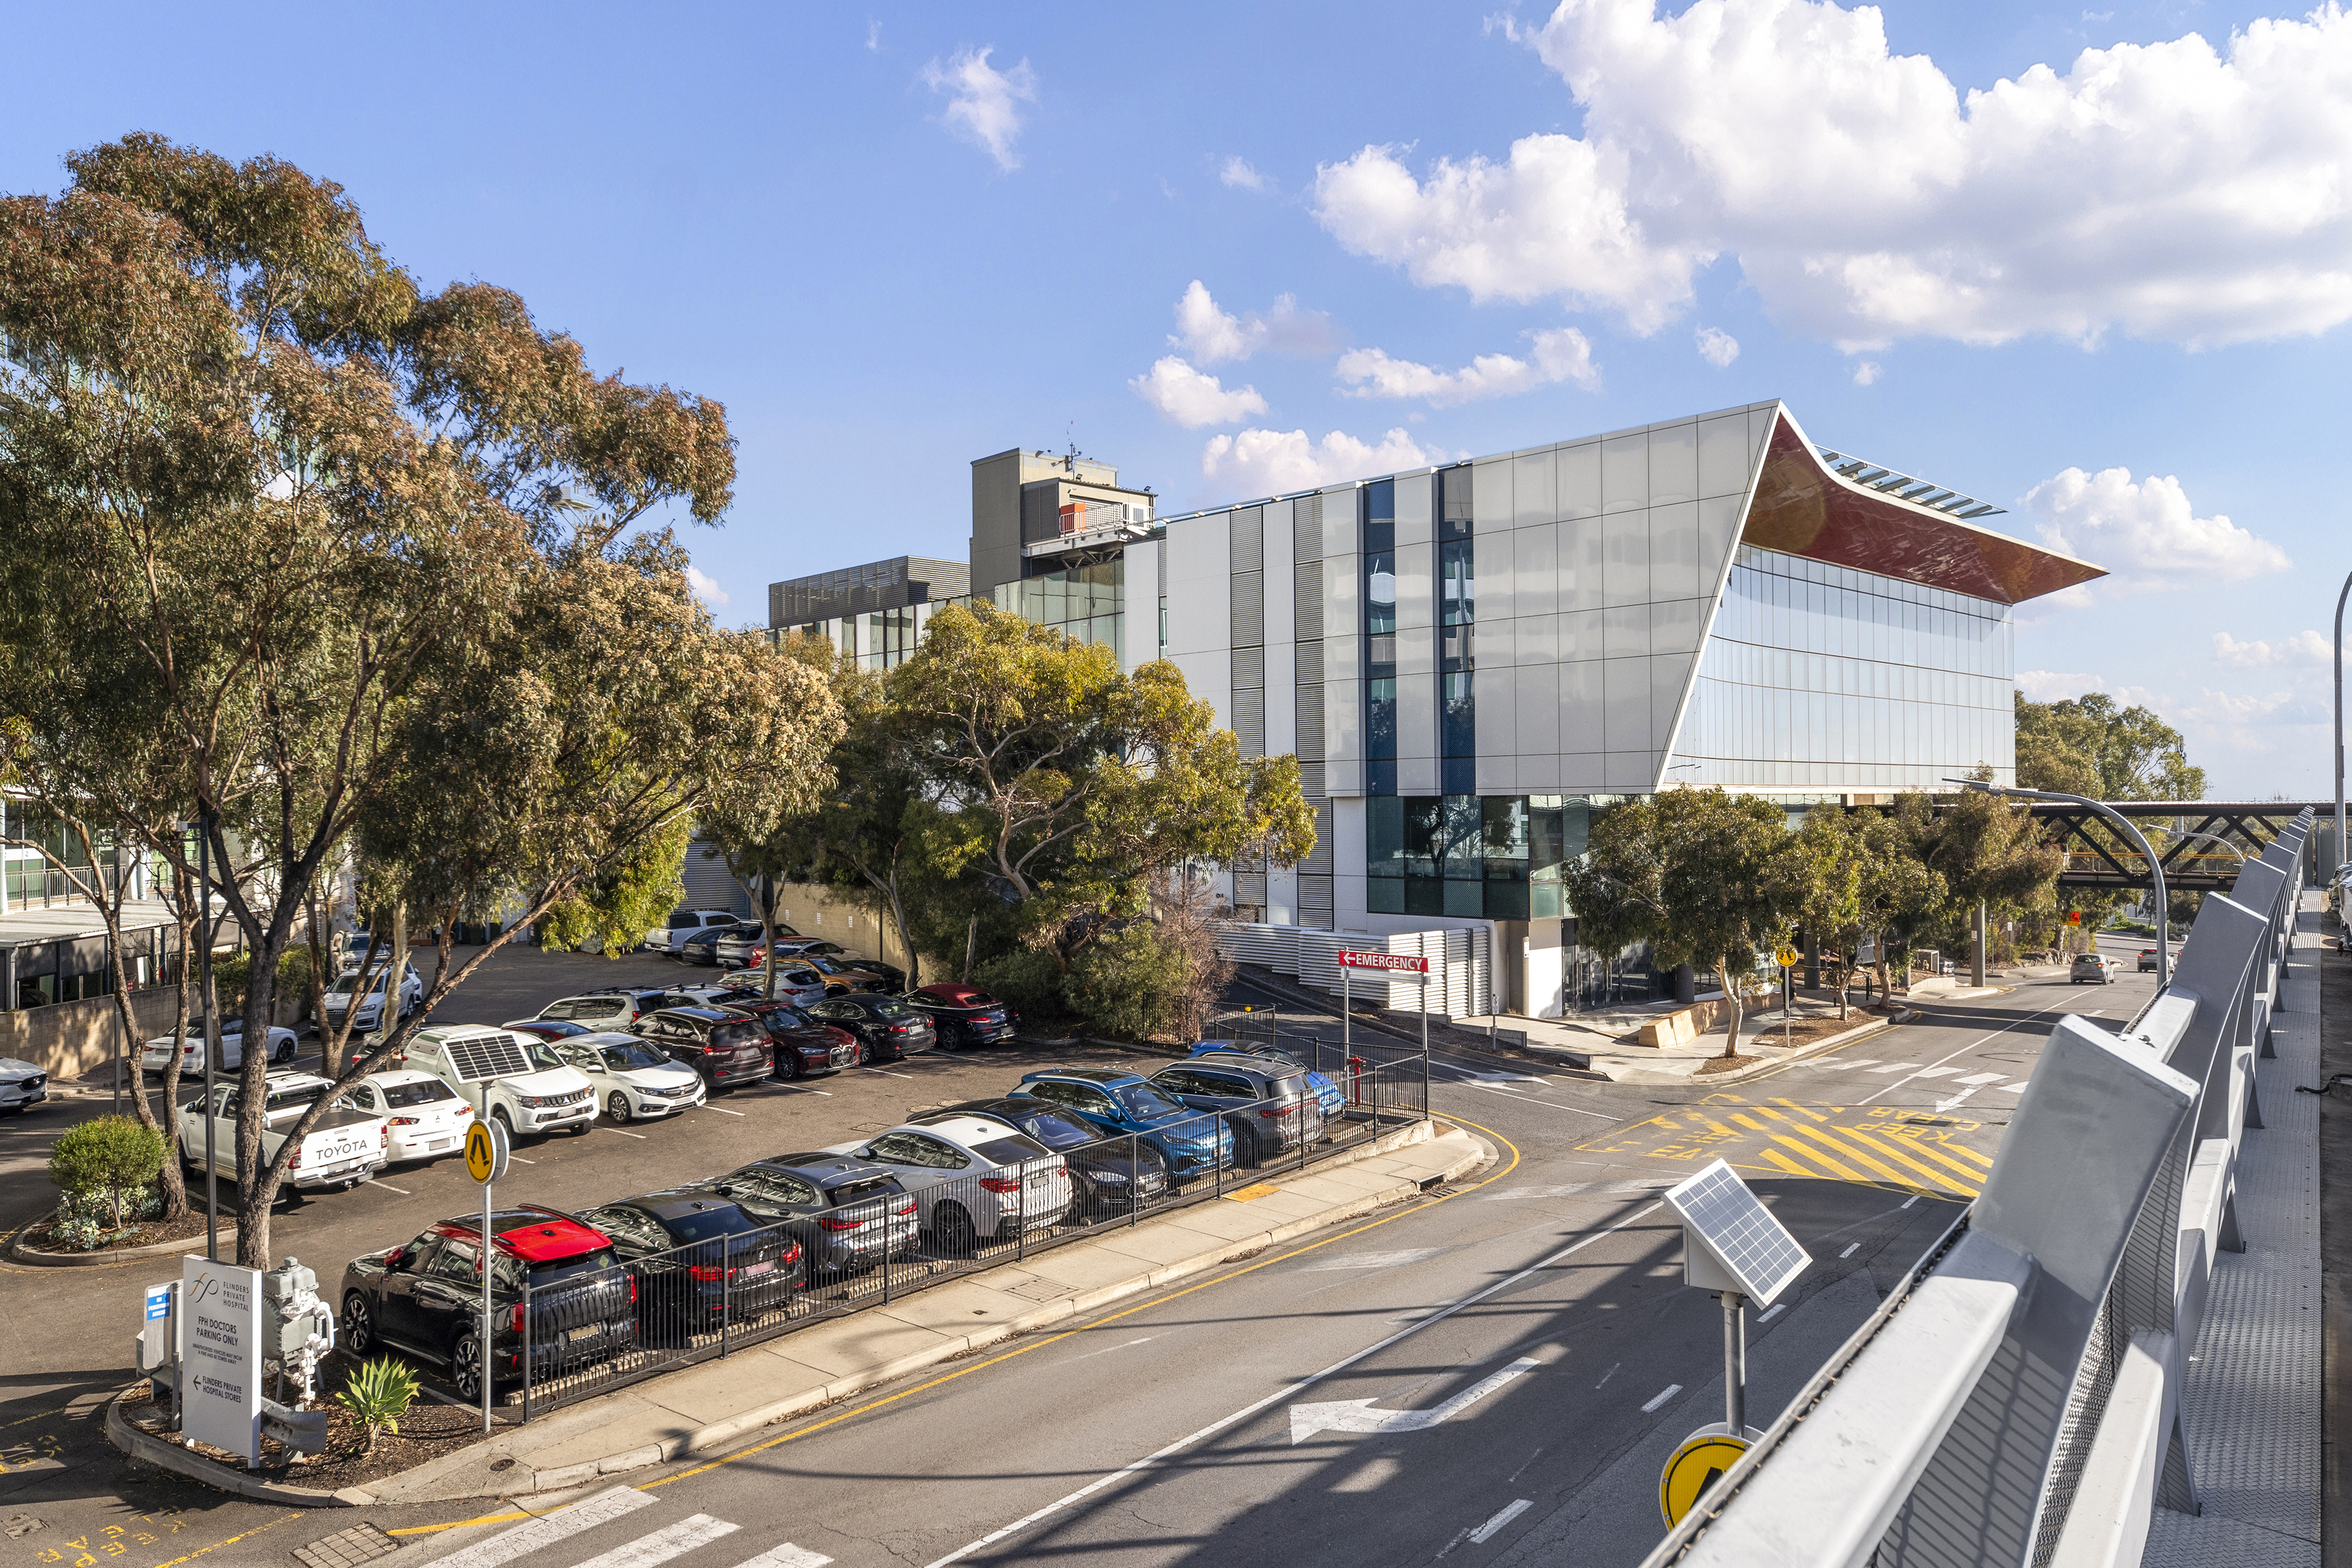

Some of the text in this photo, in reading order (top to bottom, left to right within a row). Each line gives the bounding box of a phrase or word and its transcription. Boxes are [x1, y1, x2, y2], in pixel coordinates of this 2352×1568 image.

[1356, 954, 1422, 970] EMERGENCY
[1867, 1106, 1982, 1132] CLEAR
[1853, 1122, 1955, 1143] KEEP
[316, 1140, 368, 1160] TOYOTA
[223, 1282, 249, 1294] FLINDERS
[223, 1291, 245, 1302] PRIVATE
[223, 1299, 249, 1312] HOSPITAL
[198, 1316, 236, 1334] FPH DOCTORS
[196, 1327, 238, 1346] PARKING ONLY
[192, 1343, 213, 1353] UNAUTHORISED
[202, 1376, 242, 1394] FLINDERS PRIVATE
[203, 1385, 241, 1403] HOSPITAL STORES
